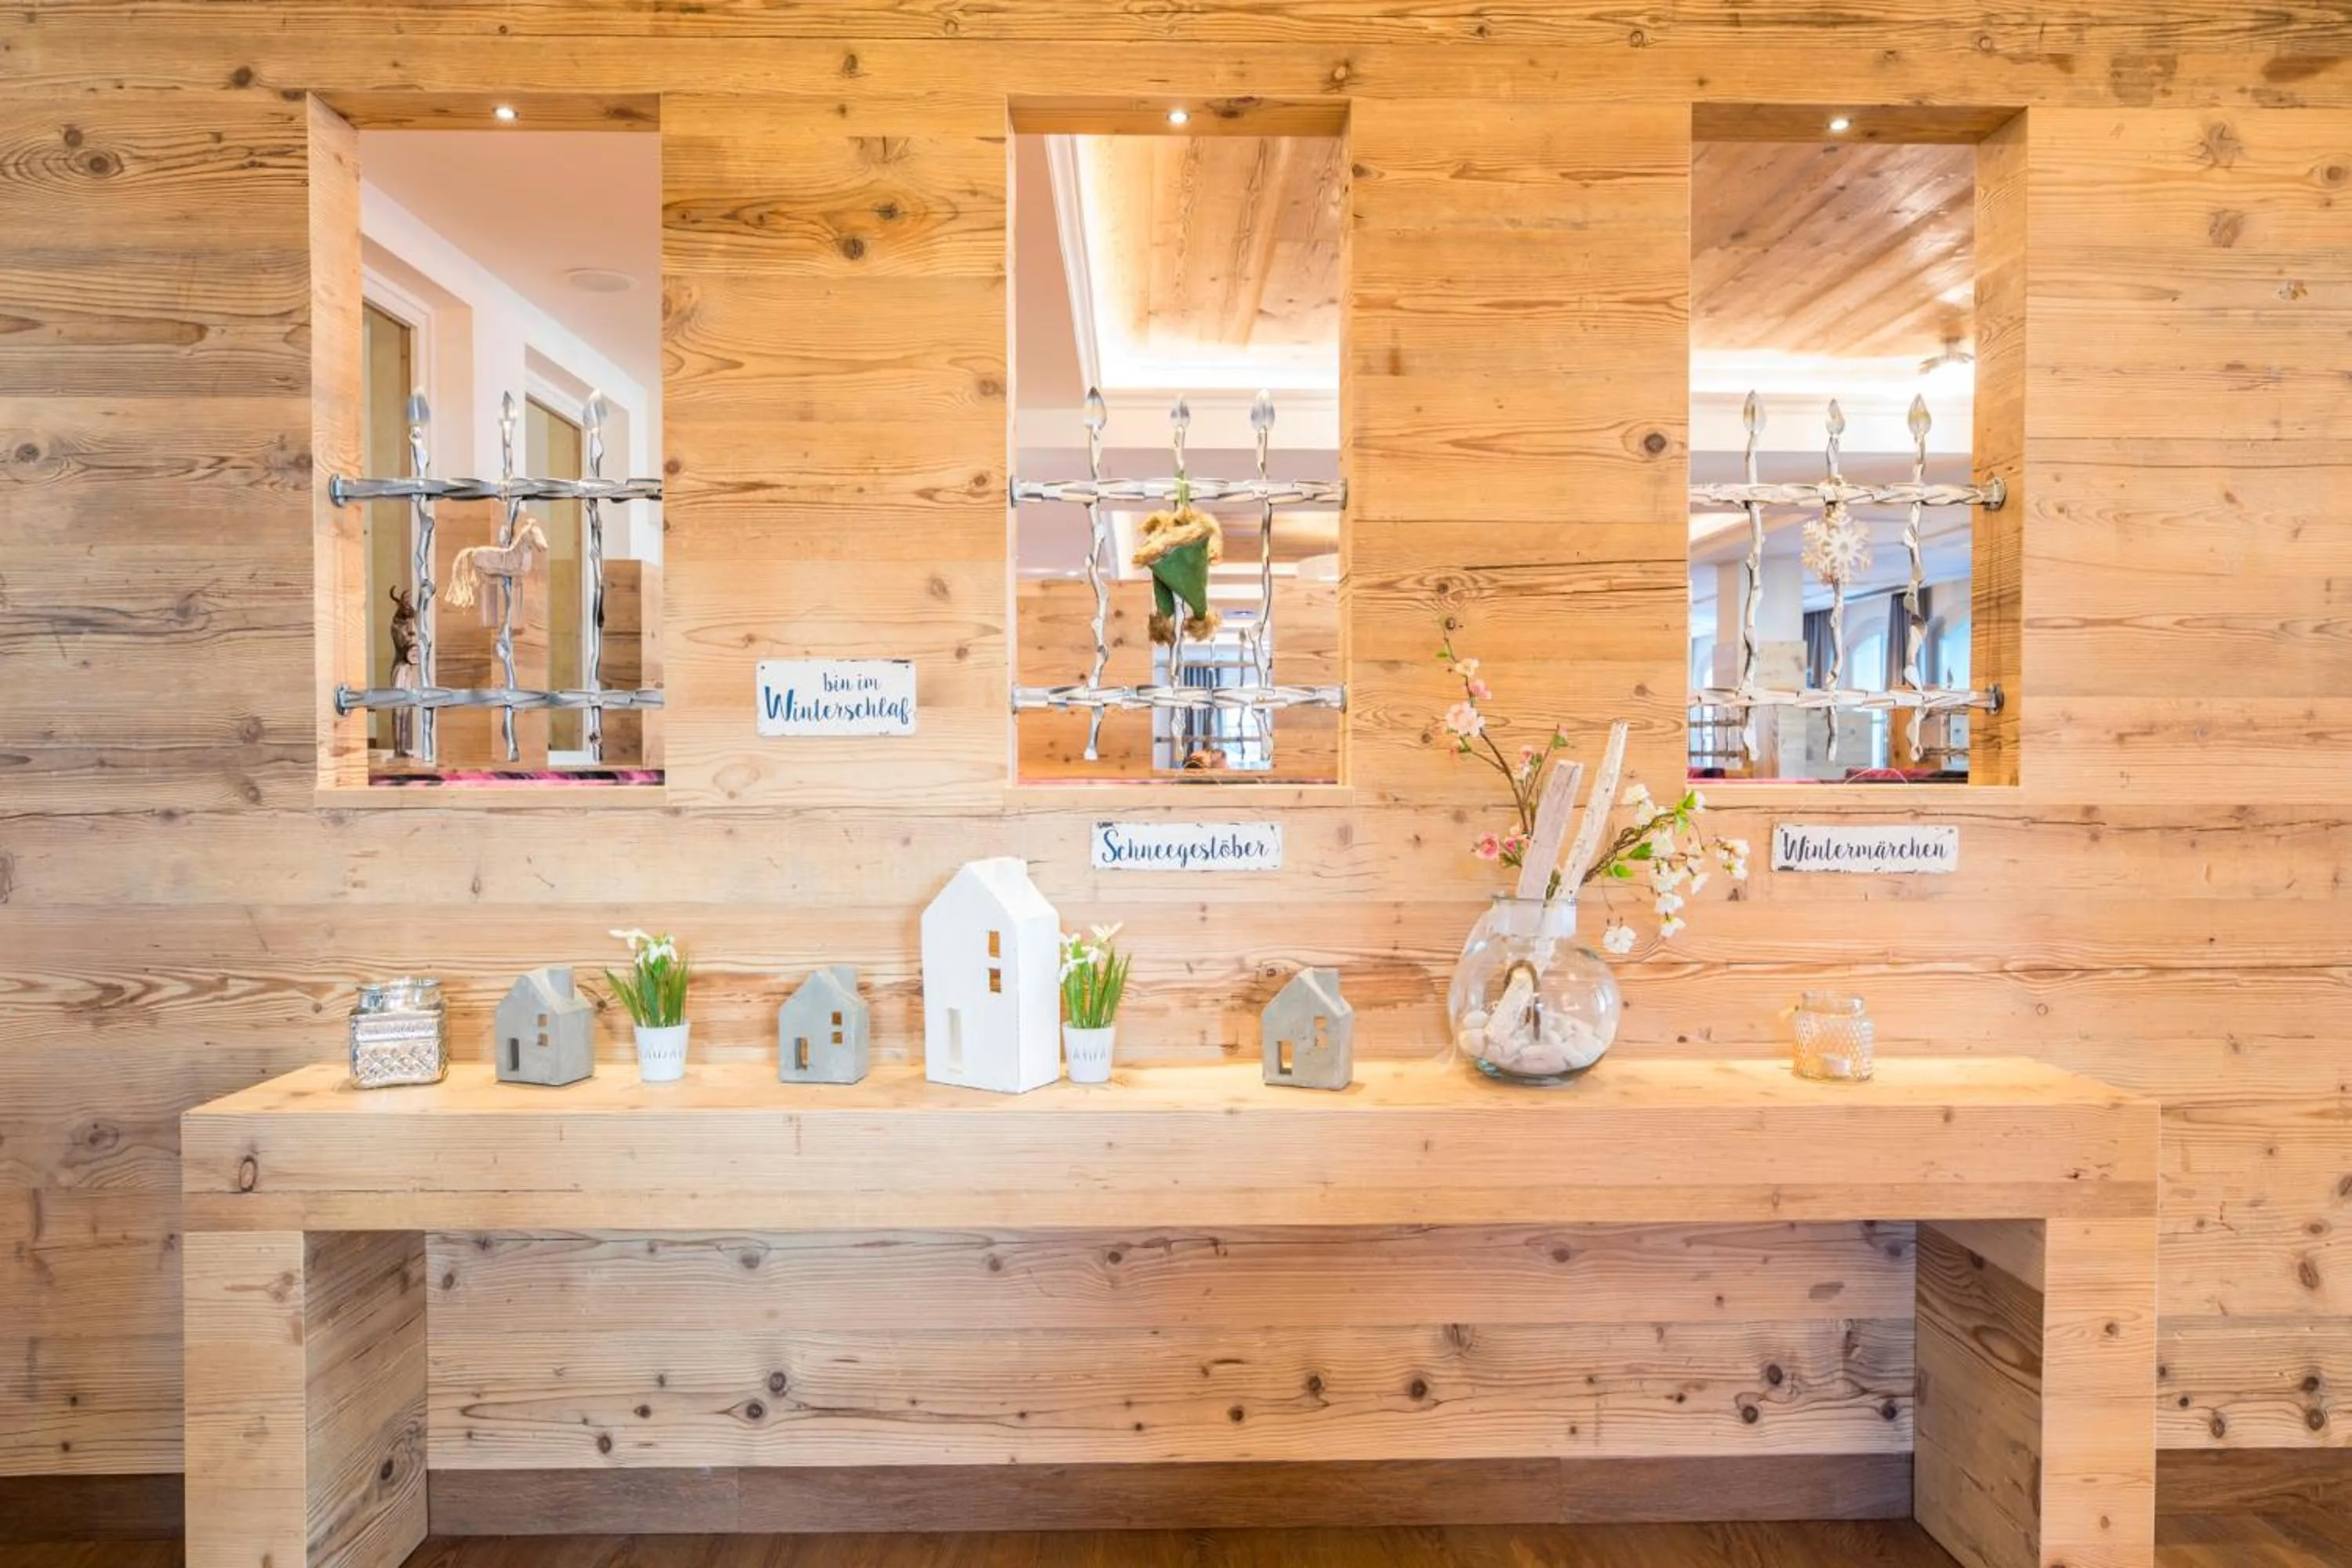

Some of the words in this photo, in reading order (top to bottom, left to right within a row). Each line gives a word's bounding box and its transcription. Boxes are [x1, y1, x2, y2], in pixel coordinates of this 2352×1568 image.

[823, 673, 852, 691] bin
[858, 673, 880, 691] im
[764, 686, 909, 724] Winterschlaf
[1102, 829, 1269, 867] Schneegestöber
[1784, 832, 1947, 862] Wintermärchen
